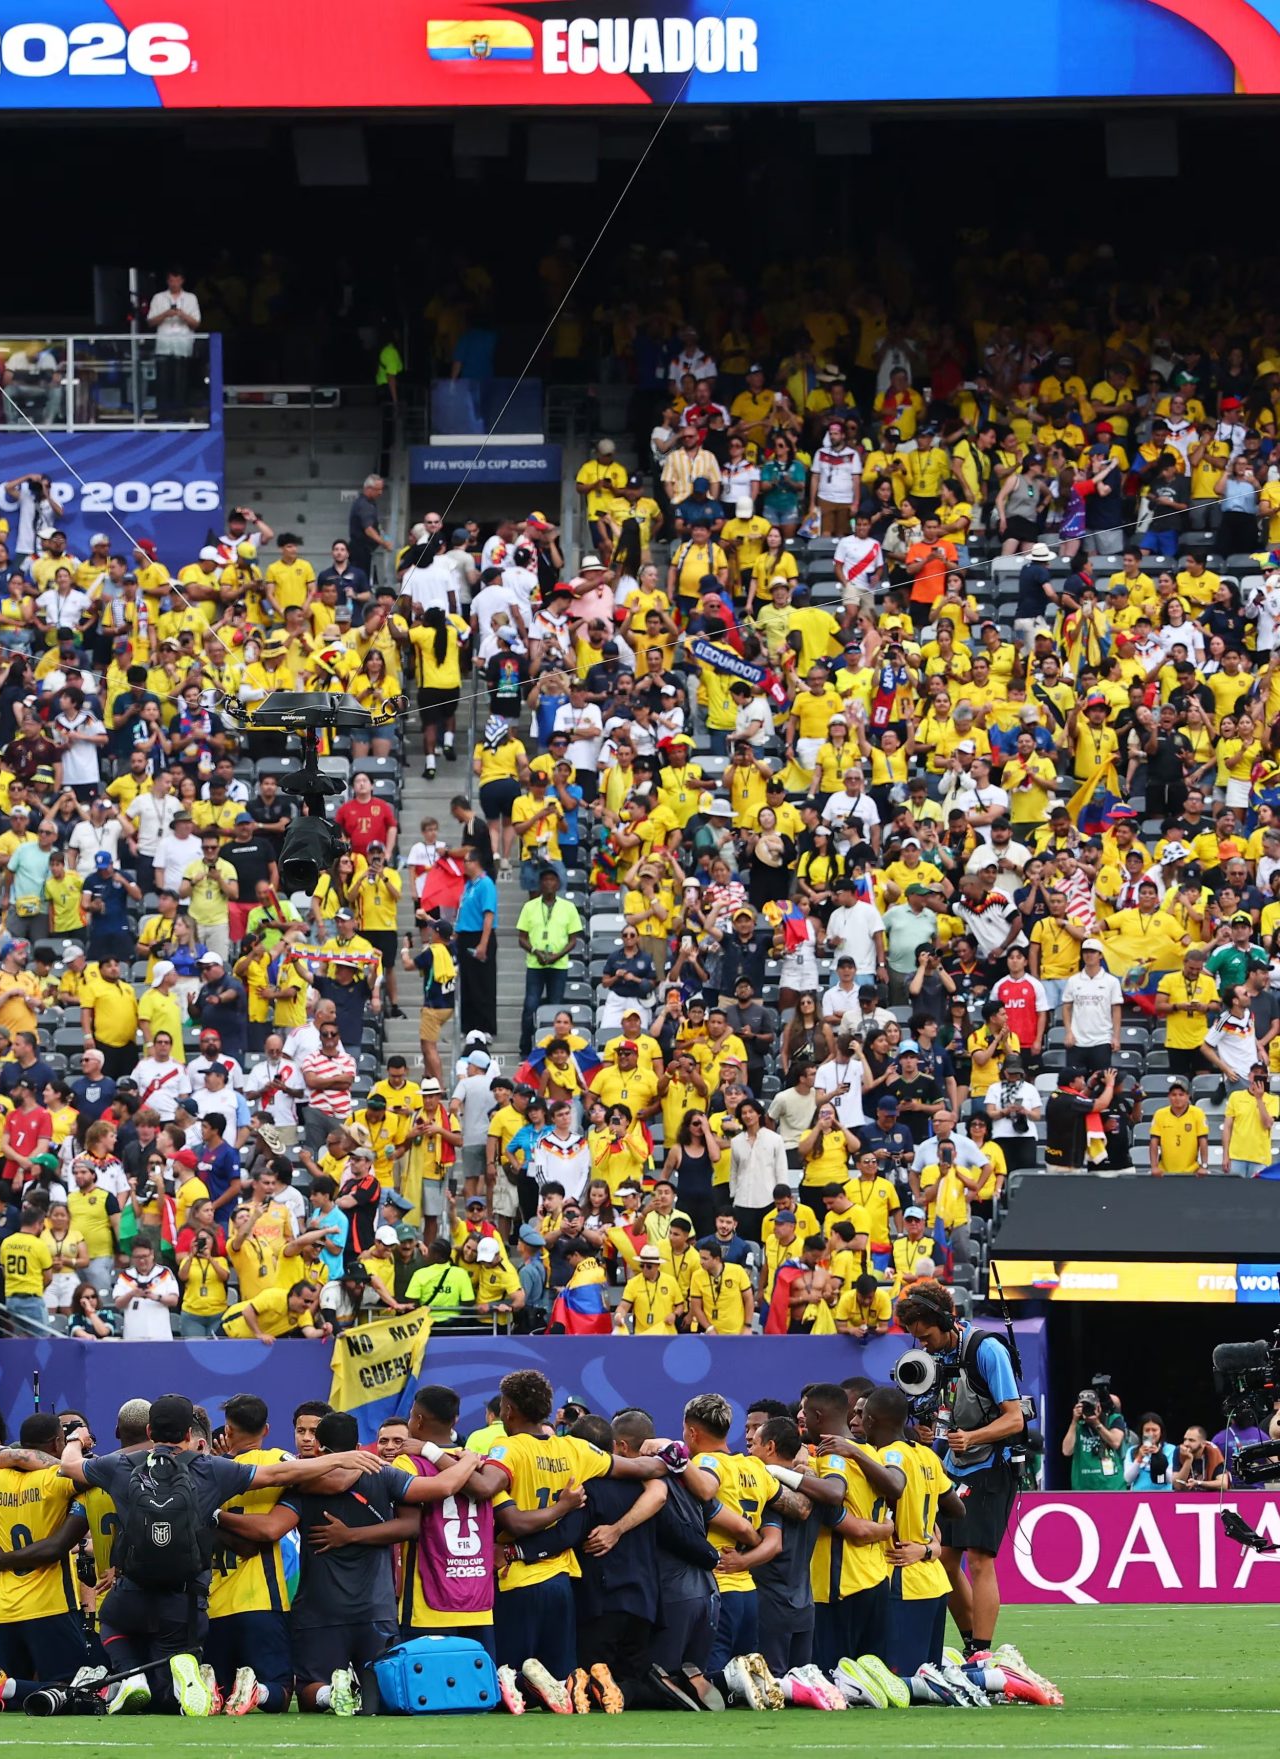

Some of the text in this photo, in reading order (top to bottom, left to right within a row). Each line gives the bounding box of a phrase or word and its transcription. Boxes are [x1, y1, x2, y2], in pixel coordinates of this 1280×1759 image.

[541, 17, 759, 75] ECUADOR
[424, 459, 548, 470] FIFA WORLD CUP 2026
[80, 480, 220, 512] 2026
[1004, 998, 1026, 1009] JVC
[16, 1131, 26, 1147] 7
[6, 1254, 27, 1275] 20
[1198, 1275, 1238, 1290] FIFA
[346, 1333, 374, 1357] NO
[446, 1558, 485, 1566] WORLD CUP
[445, 1566, 487, 1578] 2026
